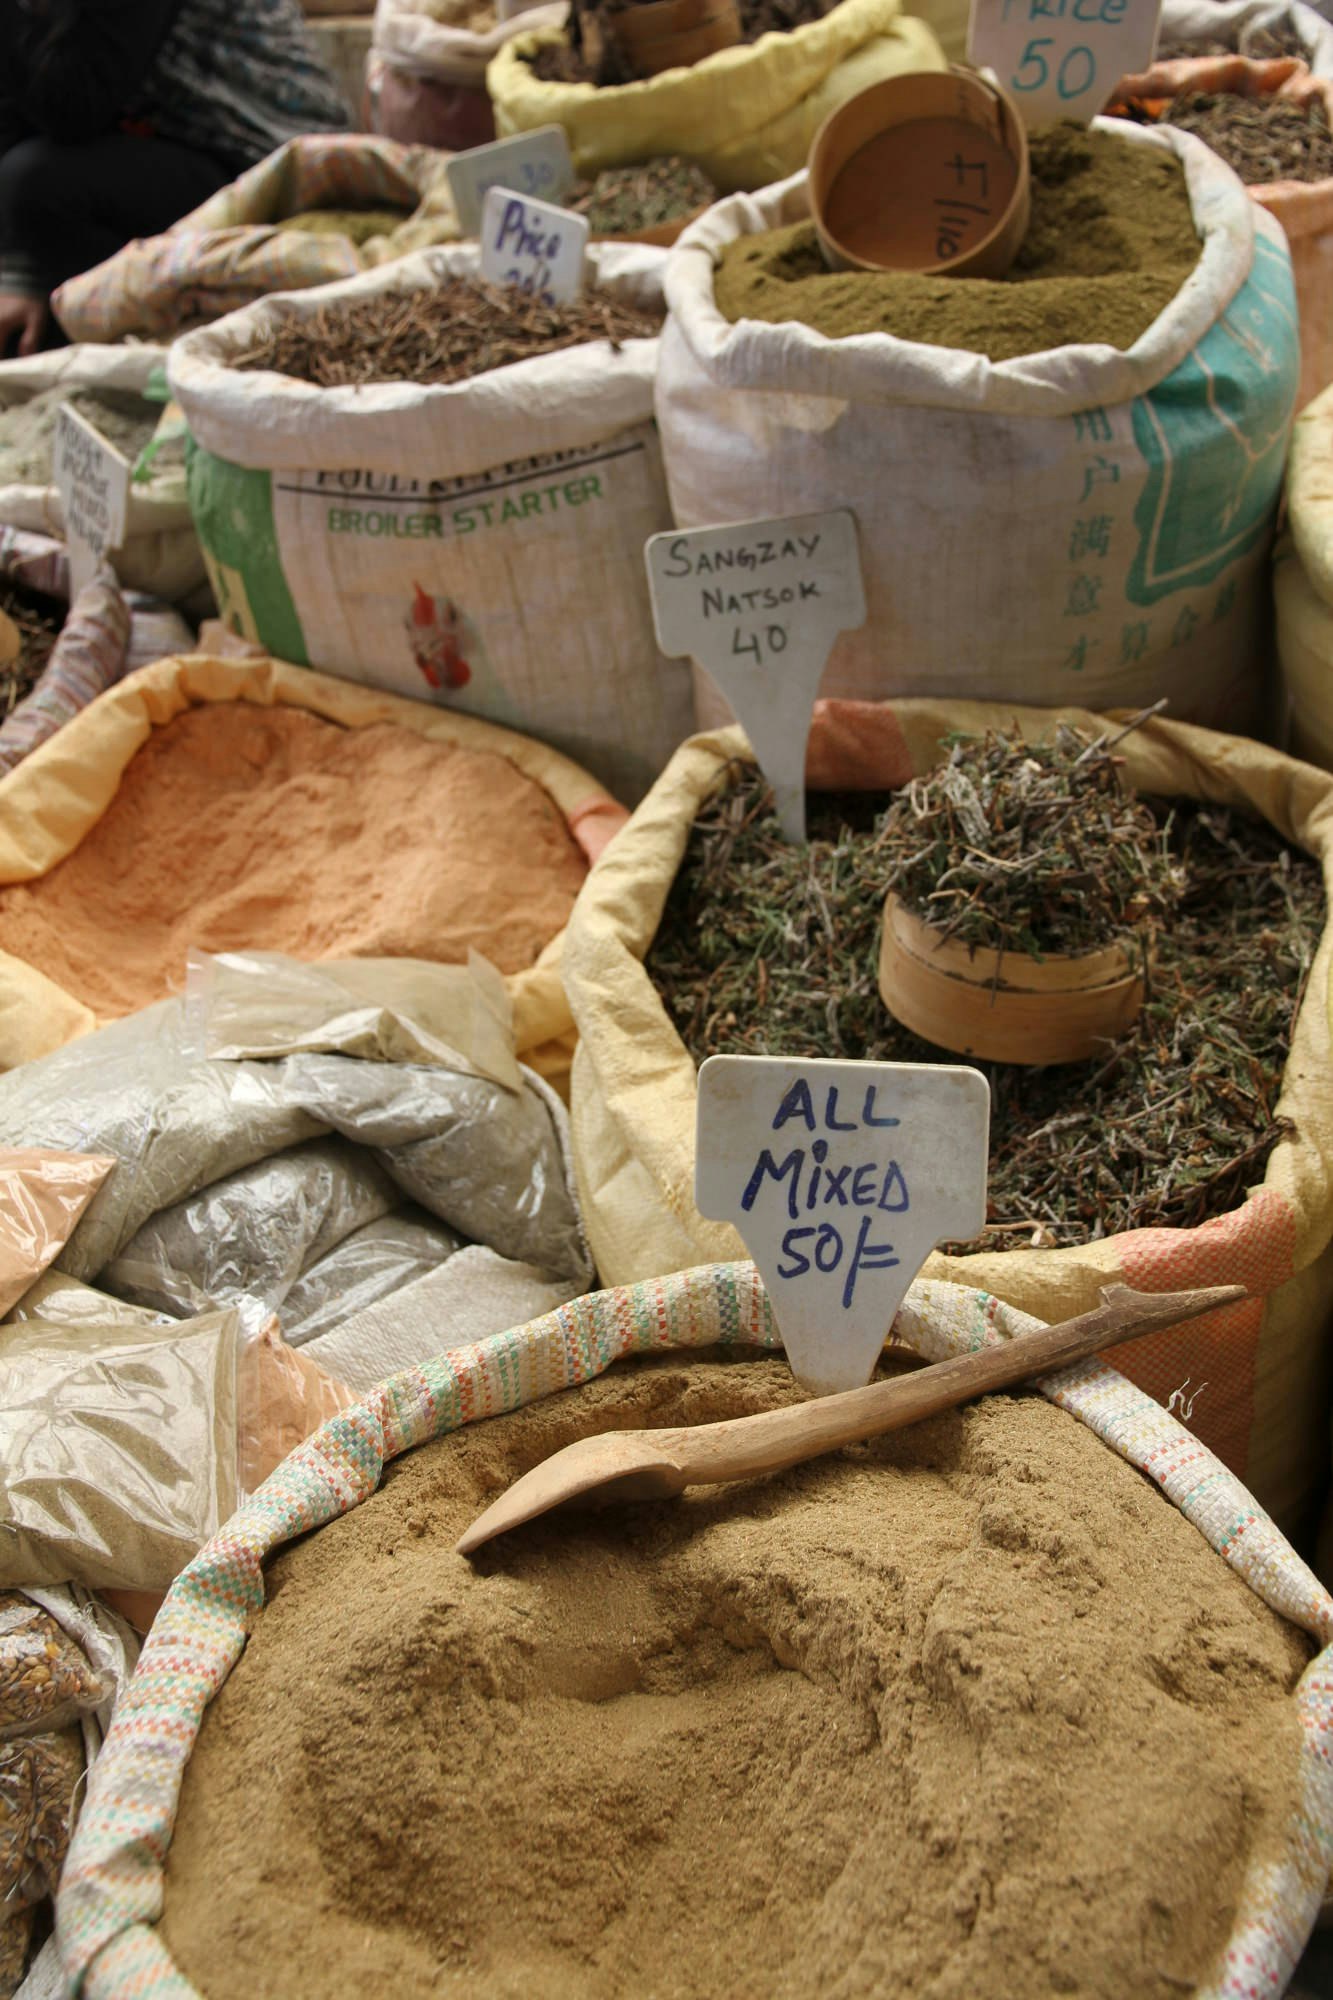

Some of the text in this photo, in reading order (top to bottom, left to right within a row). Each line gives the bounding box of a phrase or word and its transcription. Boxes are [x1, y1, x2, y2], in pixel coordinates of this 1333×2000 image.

[1012, 37, 1097, 101] 50
[494, 199, 562, 260] Price
[328, 474, 604, 539] BROILER STARTER
[663, 534, 821, 577] SANGZAY
[702, 581, 822, 619] NATSOK
[732, 623, 788, 664] 40
[772, 1078, 900, 1132] ALL
